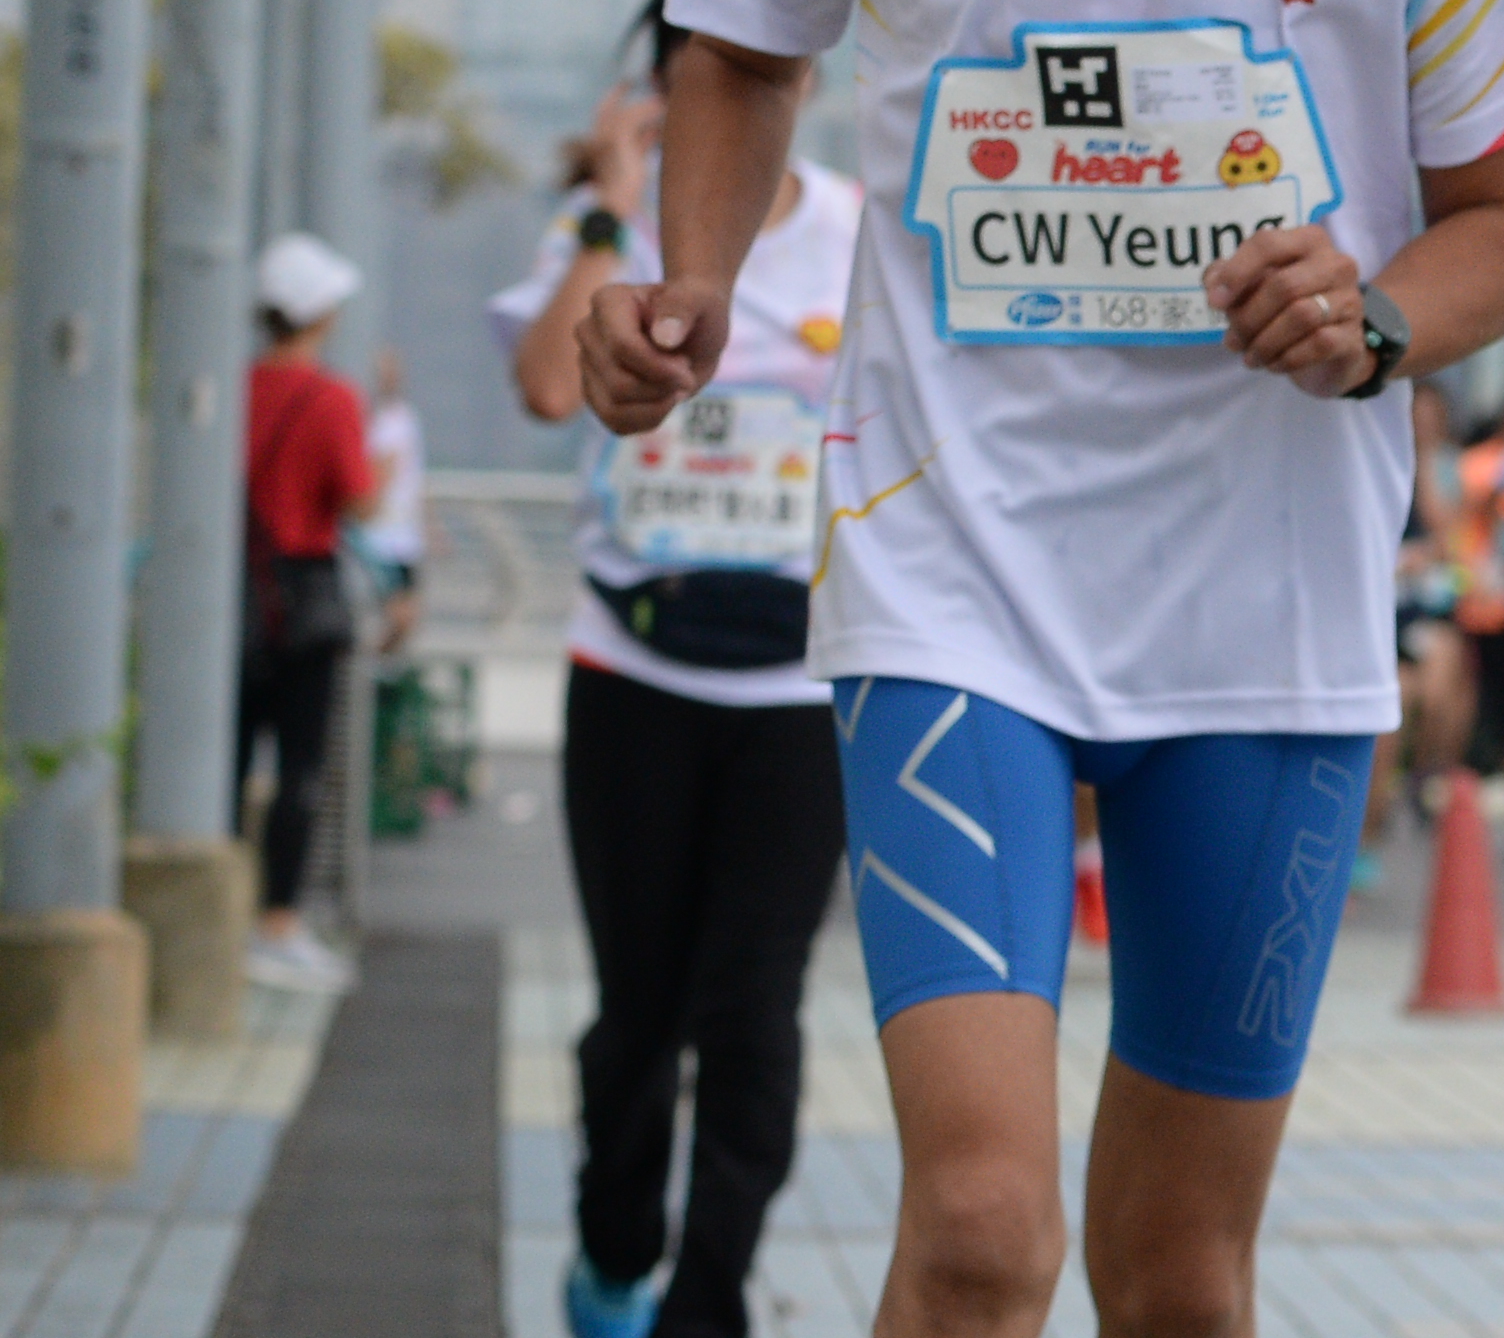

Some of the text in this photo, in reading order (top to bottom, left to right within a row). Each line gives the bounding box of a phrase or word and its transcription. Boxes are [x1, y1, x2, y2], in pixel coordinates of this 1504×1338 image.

[950, 109, 1034, 131] HKCC
[1051, 139, 1181, 184] heart
[972, 212, 1287, 266] CW Yeun
